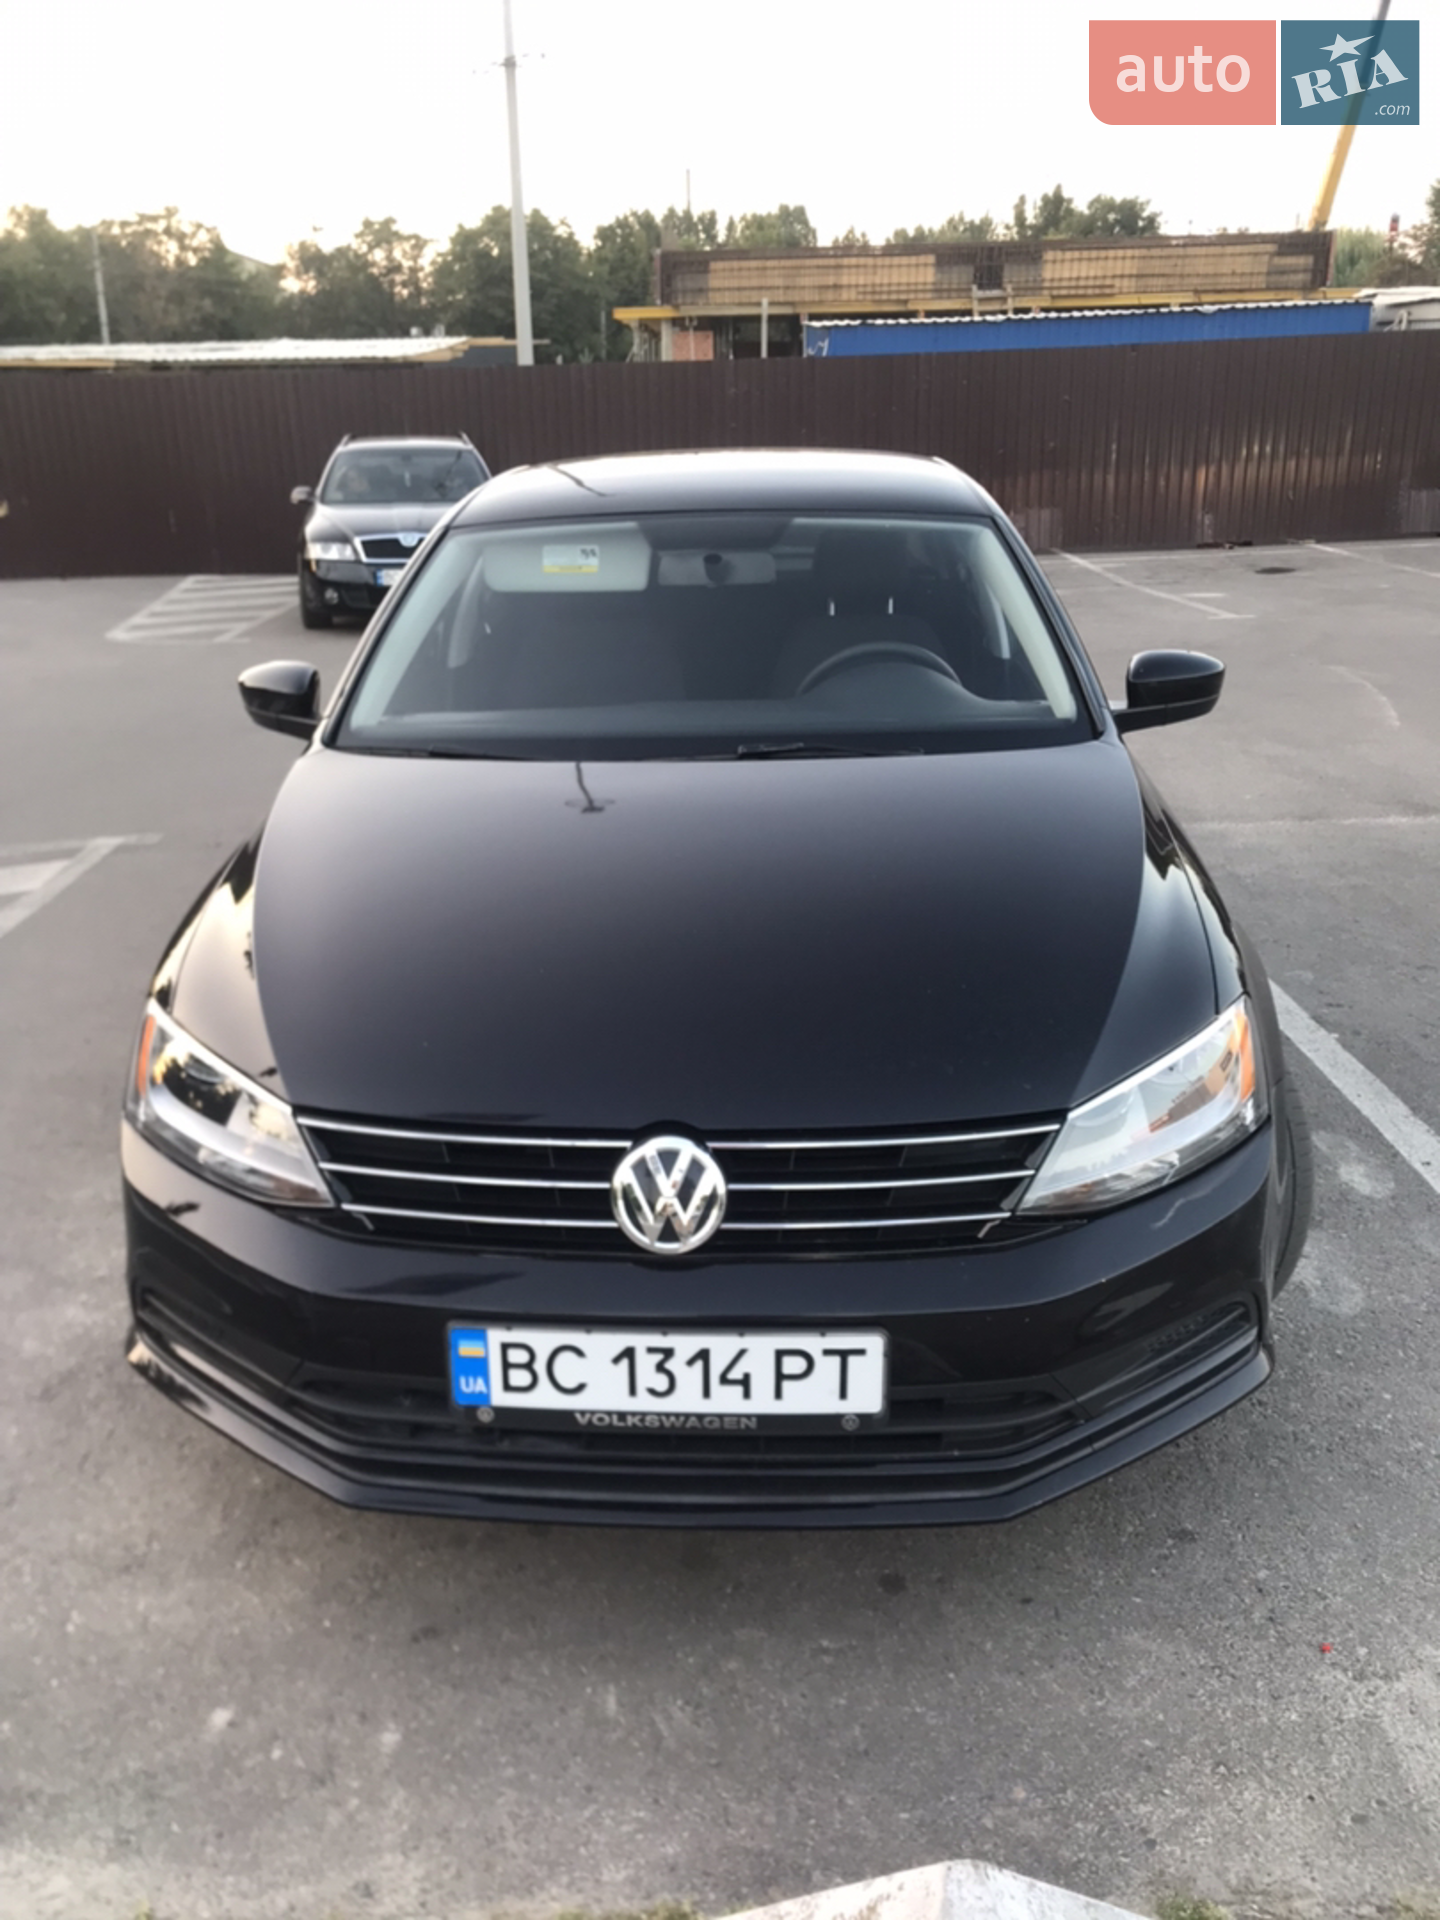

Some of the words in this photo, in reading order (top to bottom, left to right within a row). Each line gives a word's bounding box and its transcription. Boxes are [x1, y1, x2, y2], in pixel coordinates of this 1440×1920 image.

[500, 1341, 588, 1396] BC
[611, 1346, 752, 1400] 1314
[774, 1348, 867, 1401] PT
[460, 1376, 488, 1394] UA
[574, 1411, 757, 1430] VOLKSWAGEN
